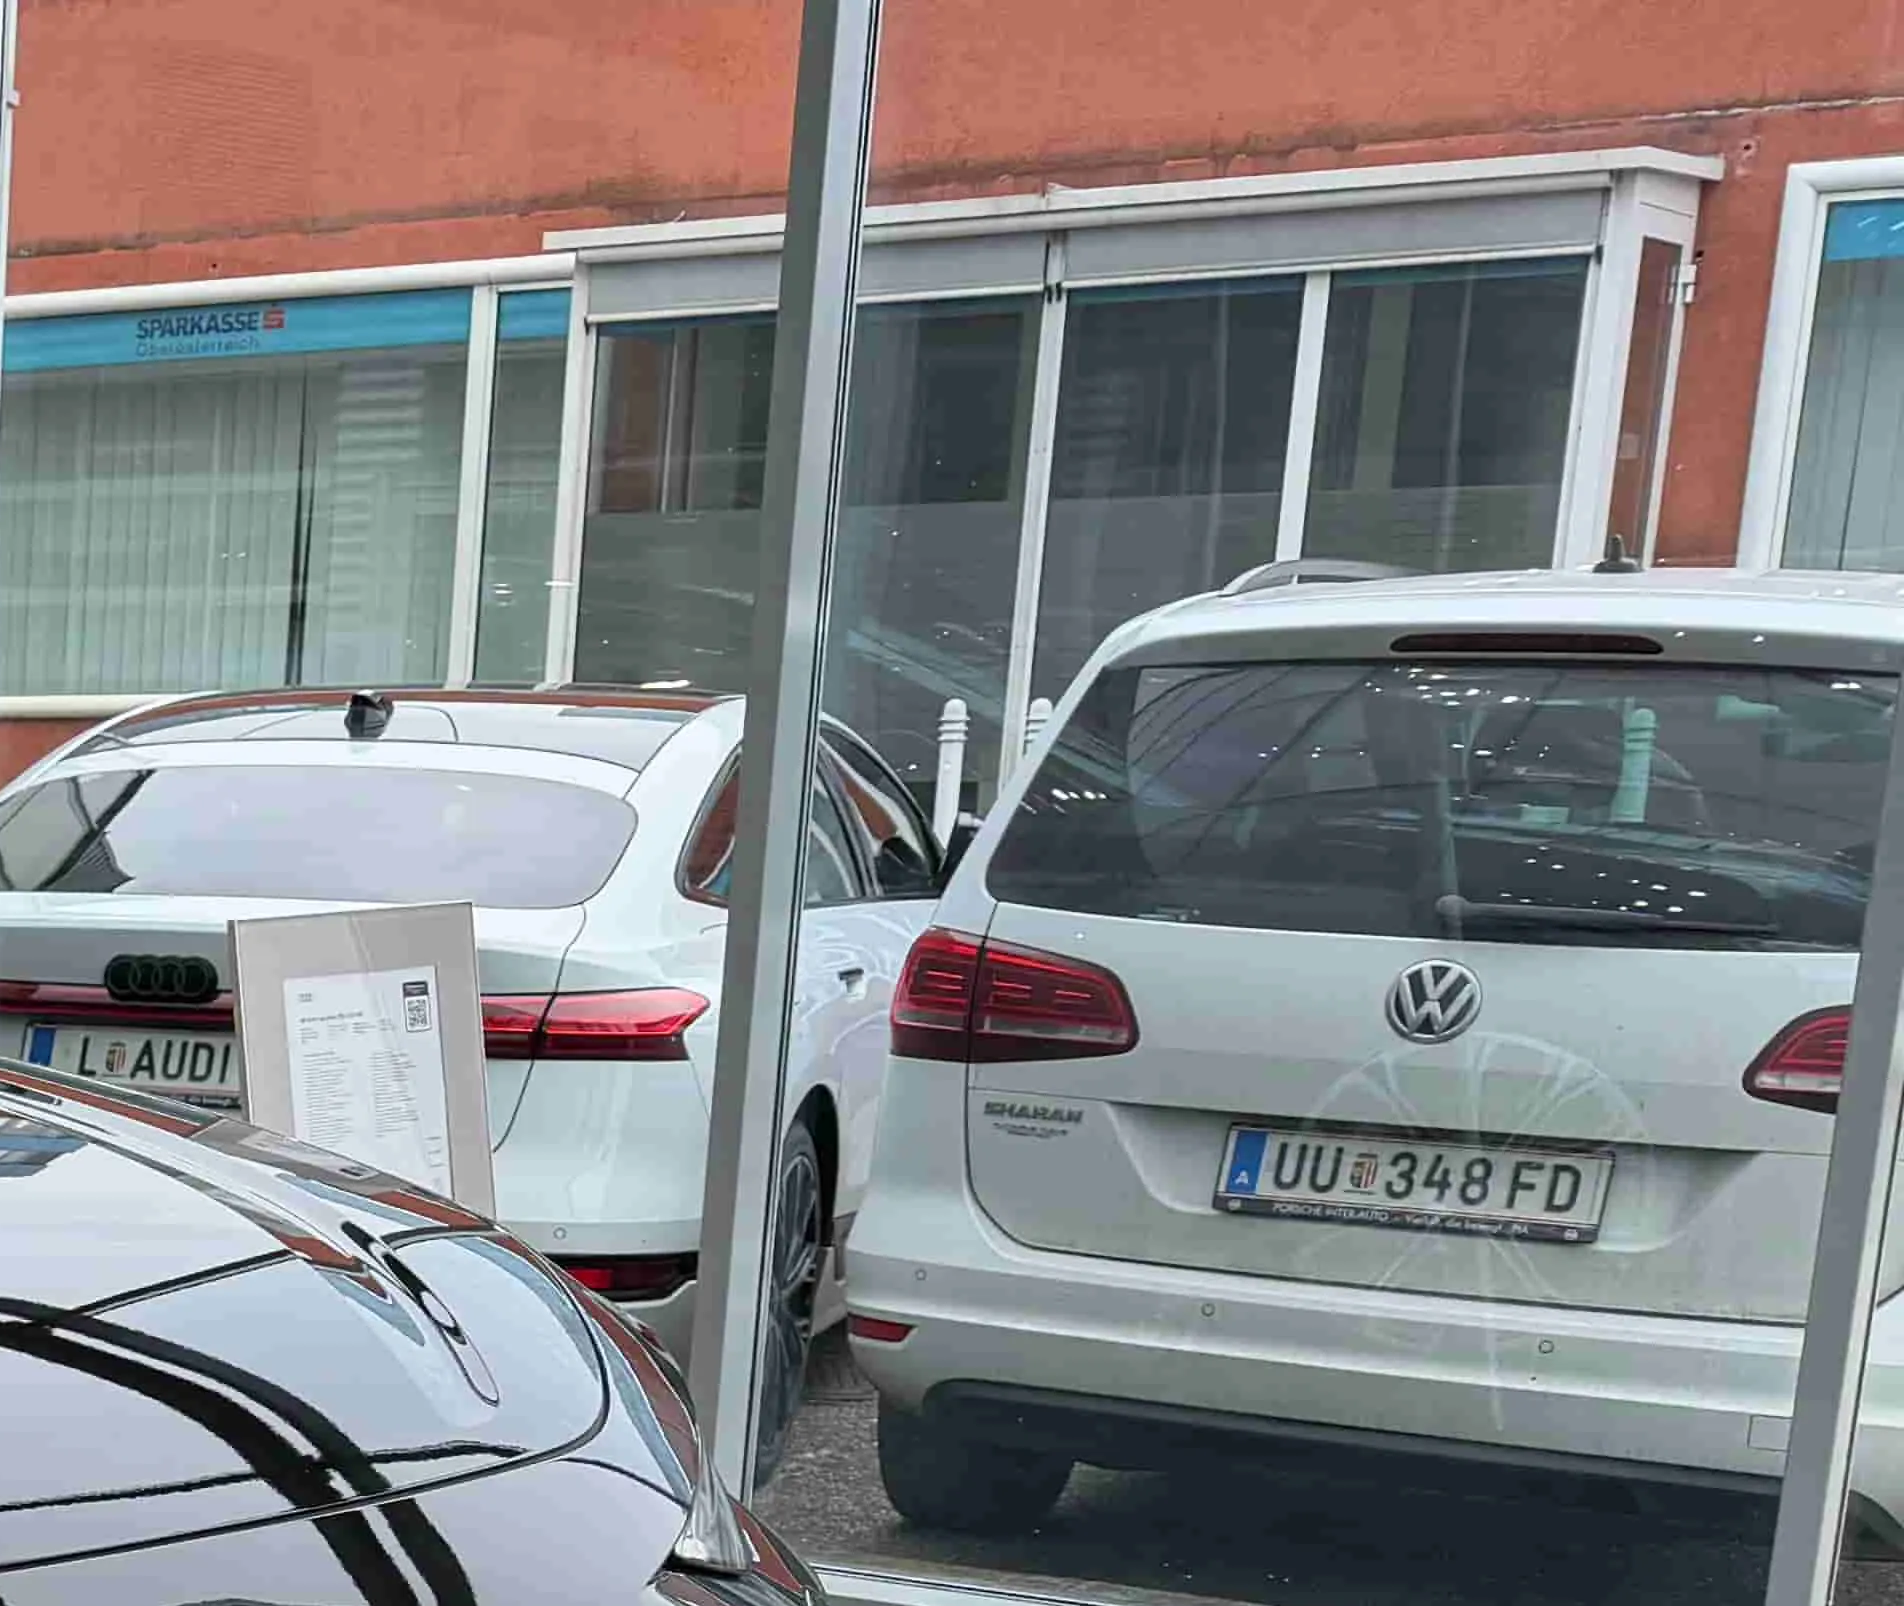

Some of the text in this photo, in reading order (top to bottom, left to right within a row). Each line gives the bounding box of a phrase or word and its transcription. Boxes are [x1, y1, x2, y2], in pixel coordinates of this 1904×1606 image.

[135, 310, 260, 339] SPARKASSE
[77, 1036, 231, 1084] L AUDI
[1273, 1141, 1583, 1213] UU 348 FD
